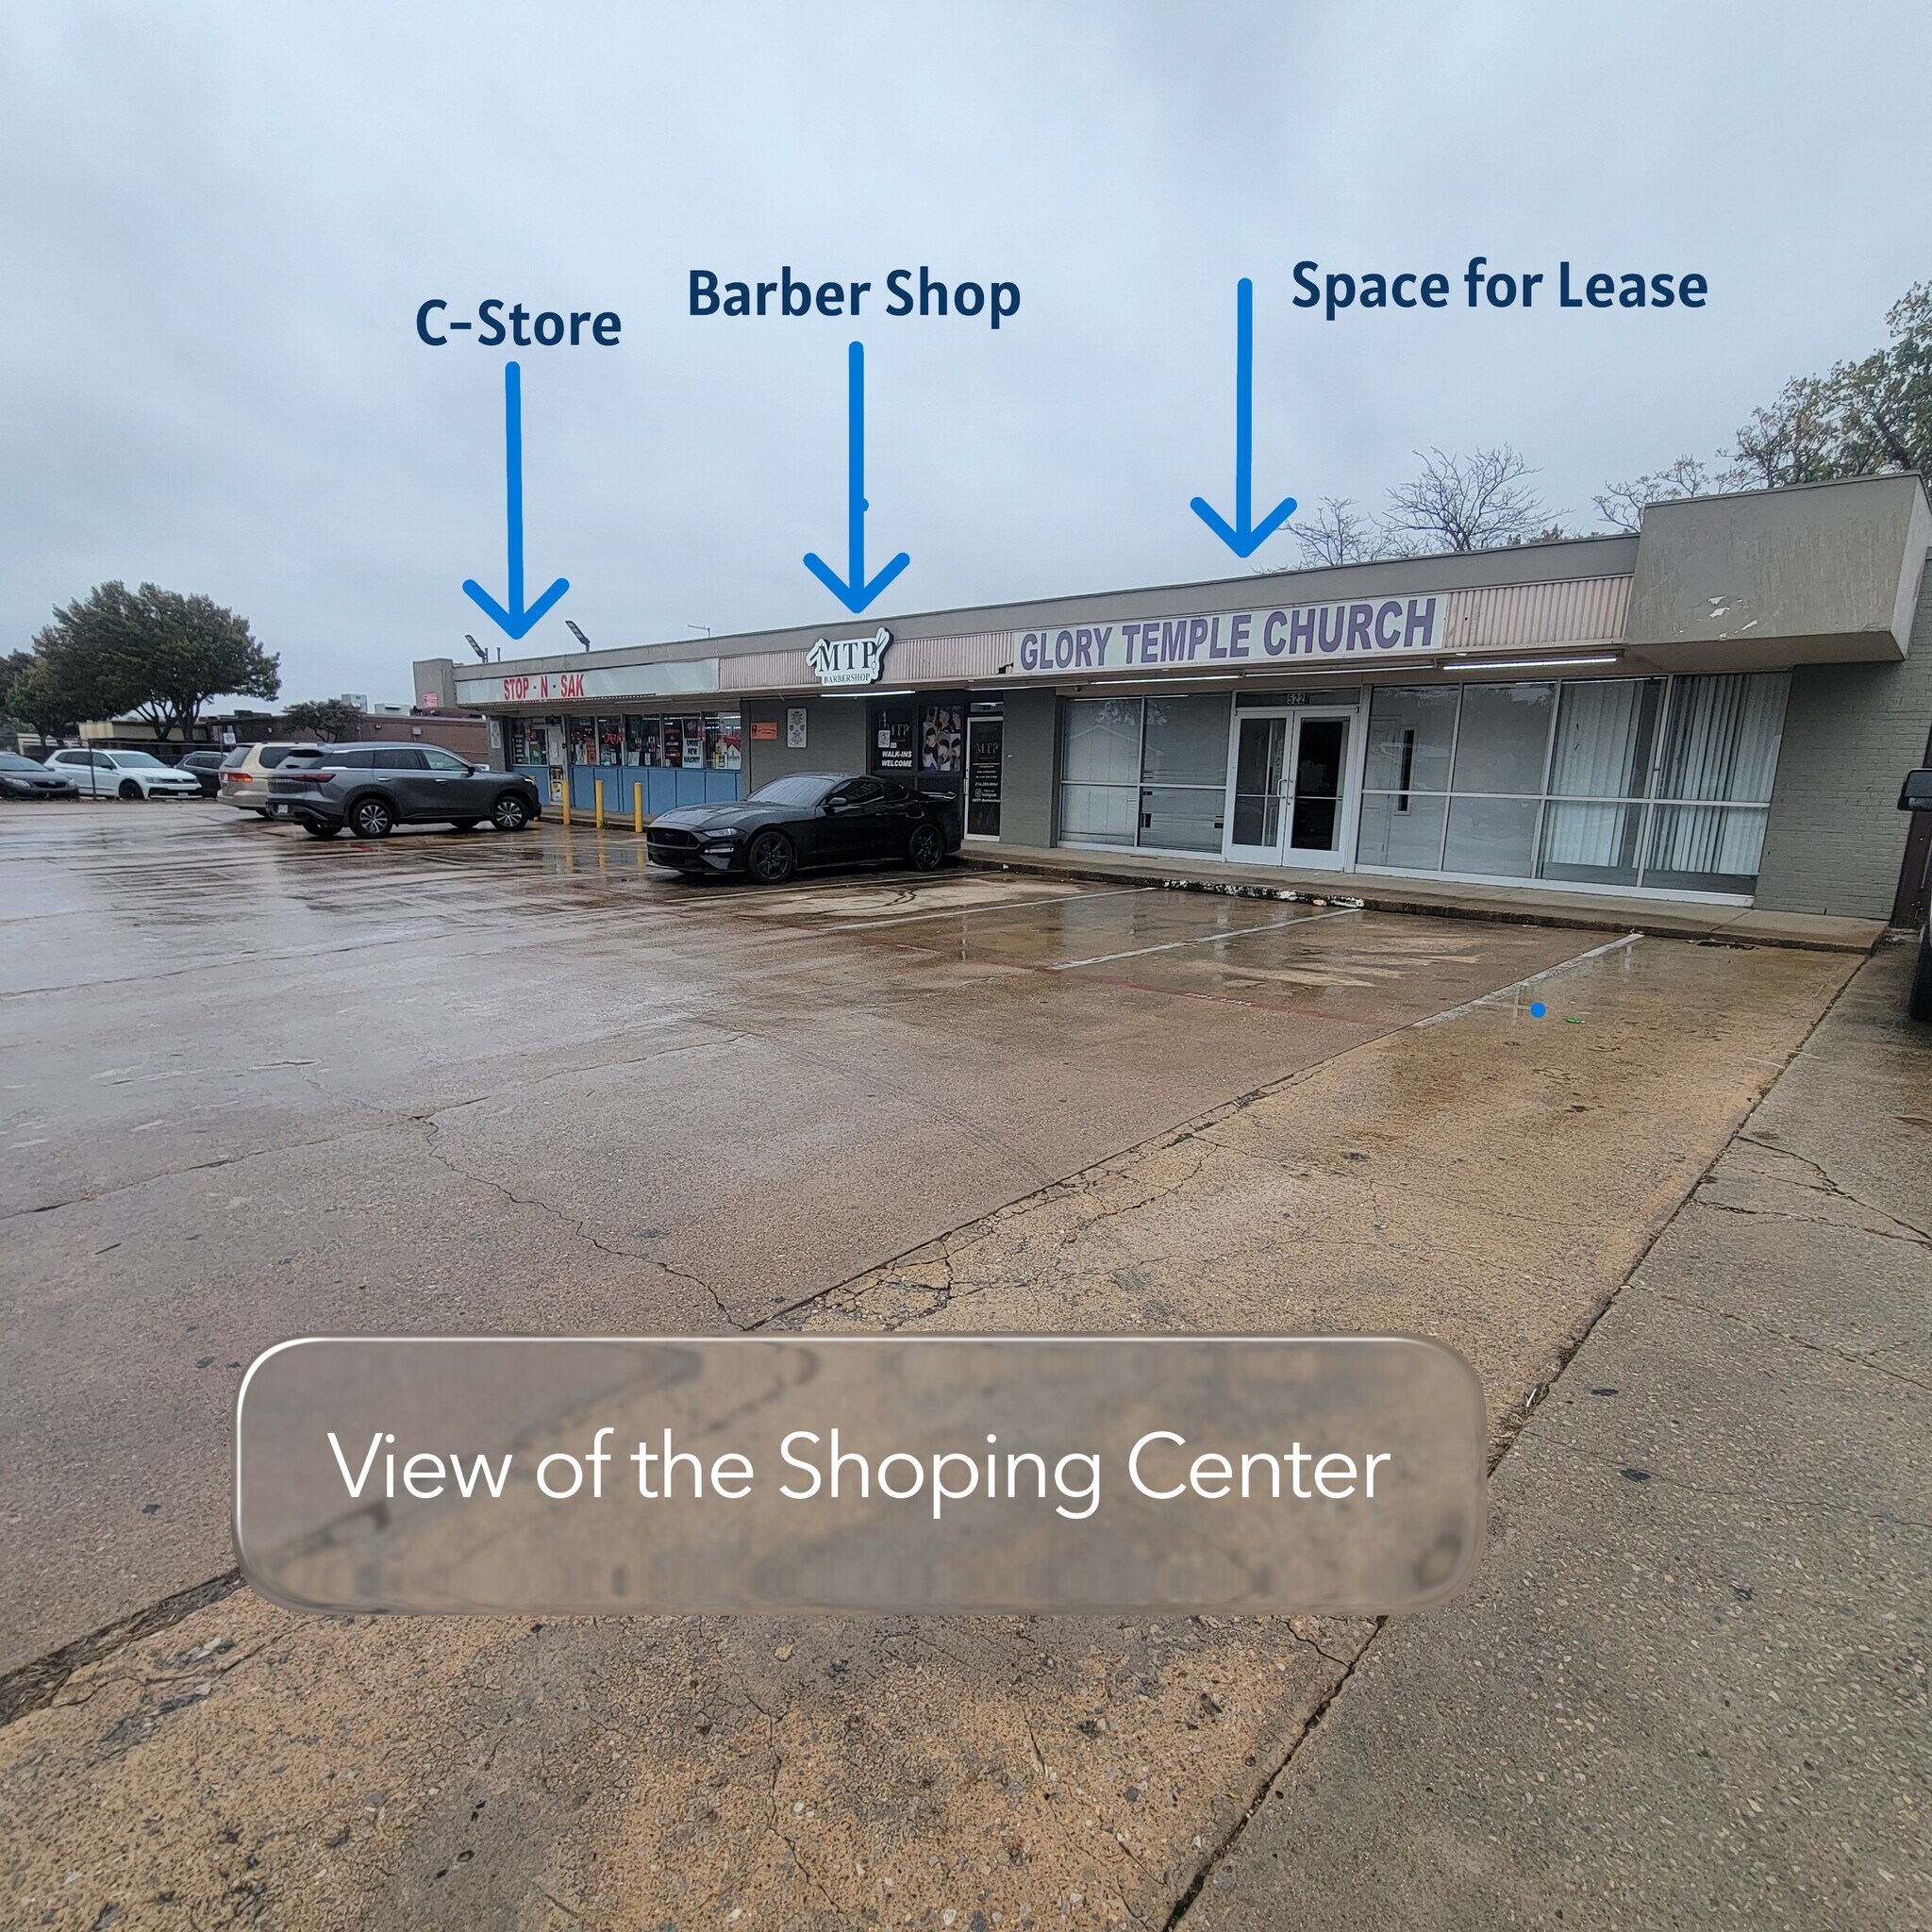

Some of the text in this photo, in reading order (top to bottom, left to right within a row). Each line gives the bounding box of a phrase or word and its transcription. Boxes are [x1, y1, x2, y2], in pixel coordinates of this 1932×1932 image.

[1020, 597, 1437, 671] GLORY TEMPLE CHURCH
[819, 641, 877, 672] MTP
[504, 674, 585, 700] STOP N SAK
[824, 674, 871, 683] BARBERSHOP
[881, 750, 912, 758] WALK-INS
